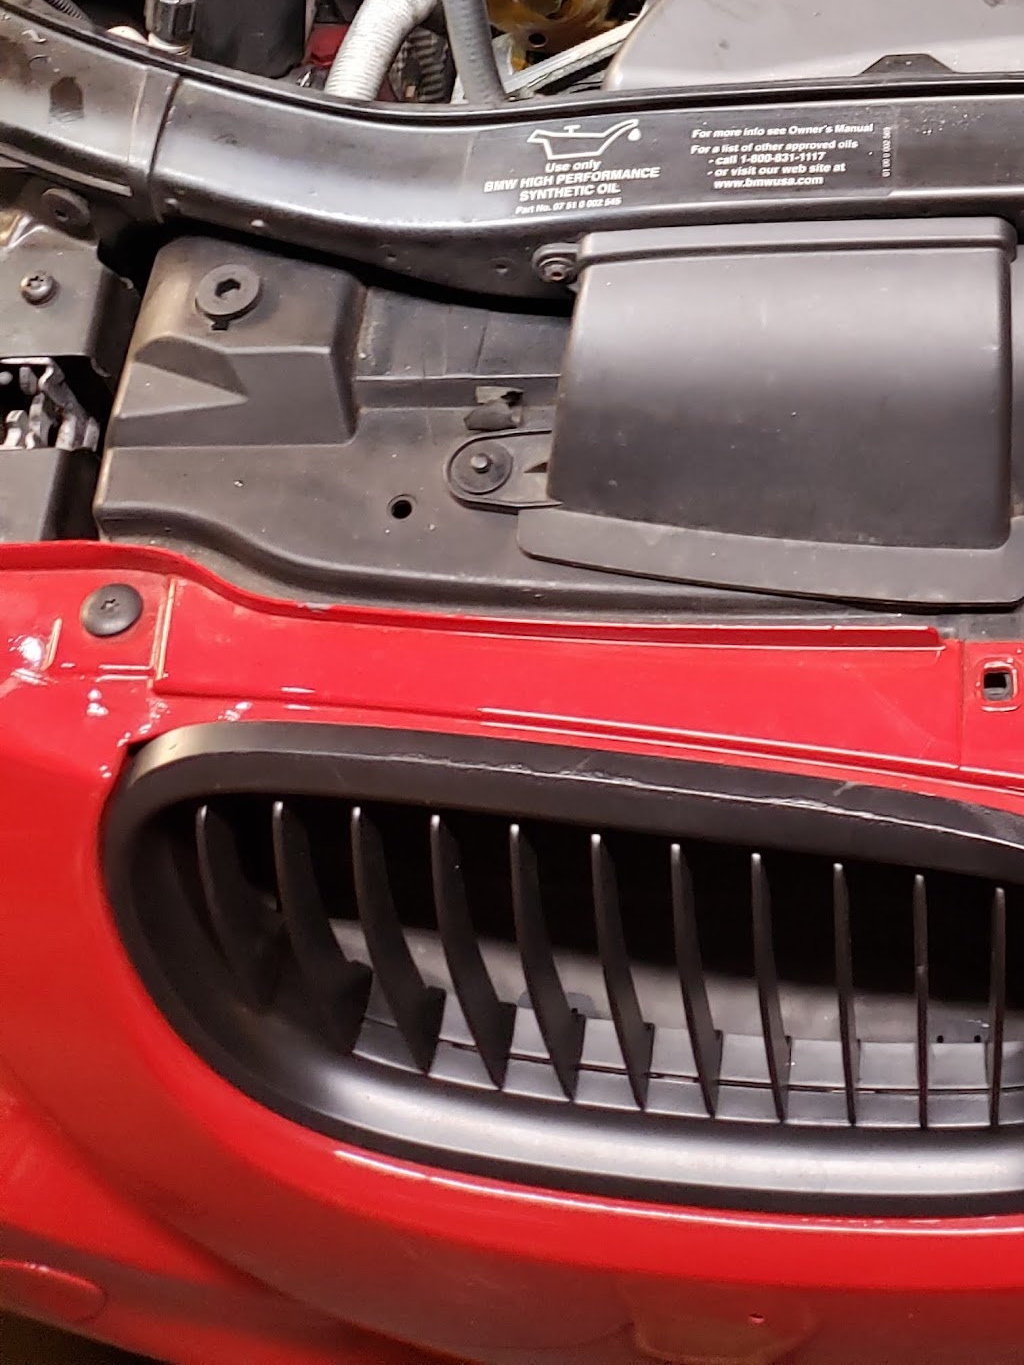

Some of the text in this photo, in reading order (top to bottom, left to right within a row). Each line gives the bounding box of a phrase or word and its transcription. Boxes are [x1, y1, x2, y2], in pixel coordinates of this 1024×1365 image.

[692, 123, 874, 138] For more info see Owner's Manual
[690, 145, 711, 154] For
[722, 143, 739, 153] list
[741, 143, 753, 152] of
[755, 141, 783, 151] other
[785, 140, 836, 152] approved
[838, 139, 858, 149] oils
[715, 154, 737, 165] call
[741, 152, 826, 164] 1-800-831-1117
[545, 160, 602, 173] Use only
[715, 168, 728, 177] or
[731, 166, 757, 177] visit
[759, 165, 780, 175] our
[782, 164, 807, 173] web
[809, 163, 831, 173] site
[833, 163, 846, 172] at
[484, 167, 661, 193] BMW HIGH PERFORMANCE
[714, 177, 824, 189] www.bmwusa.com
[519, 183, 621, 202] SYNTHETIC OIL
[515, 205, 534, 215] Part
[536, 204, 551, 213] No.
